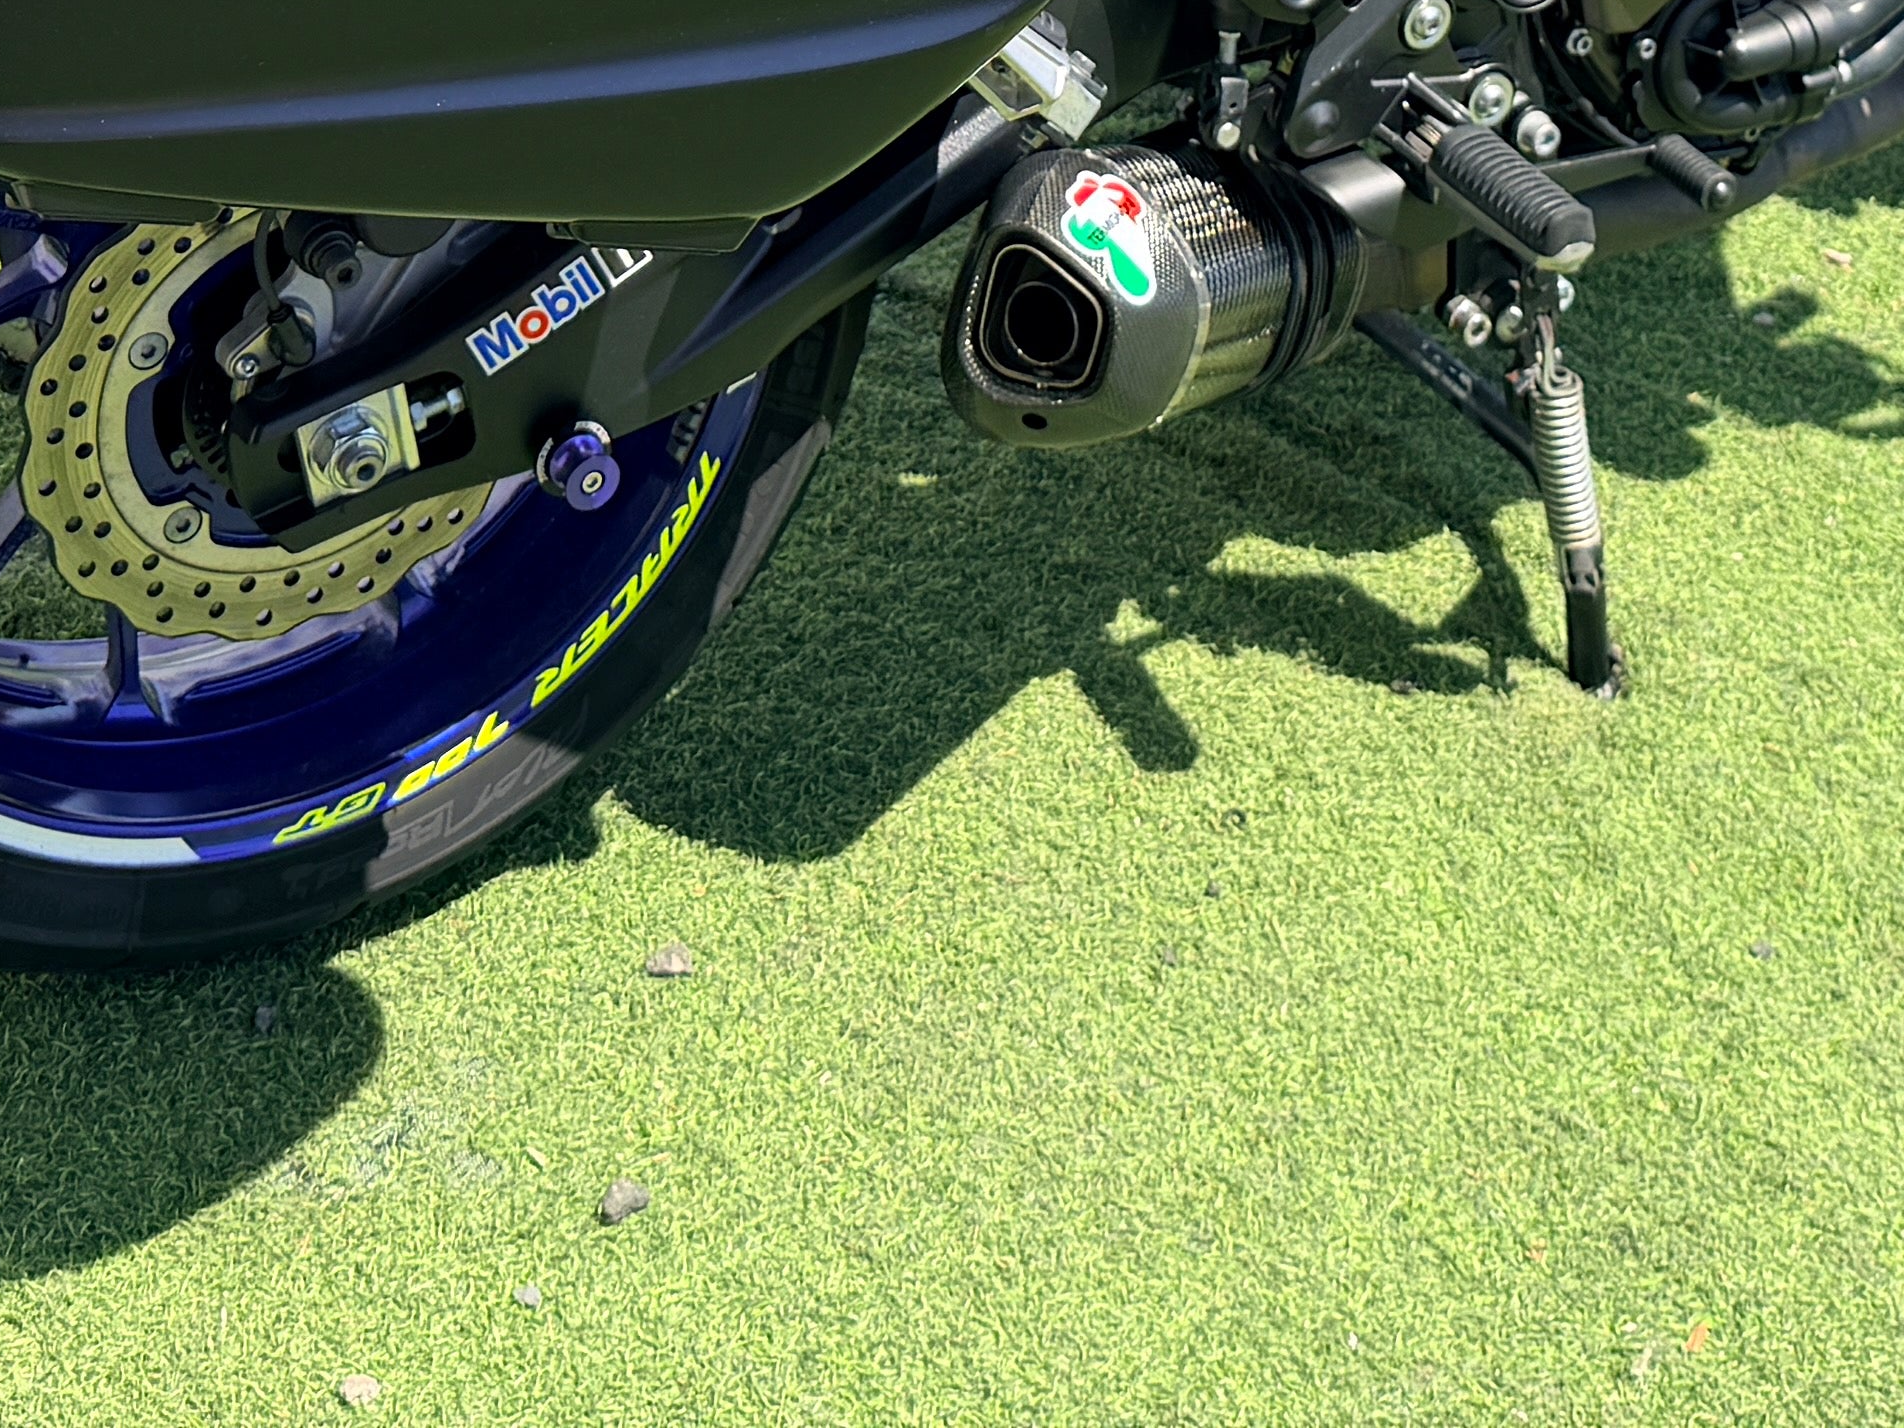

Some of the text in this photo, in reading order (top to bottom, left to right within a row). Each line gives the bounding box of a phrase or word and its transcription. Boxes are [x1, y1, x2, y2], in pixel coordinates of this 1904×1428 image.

[469, 257, 603, 373] Mobil
[530, 450, 722, 710] TRACER
[392, 711, 510, 802] 700
